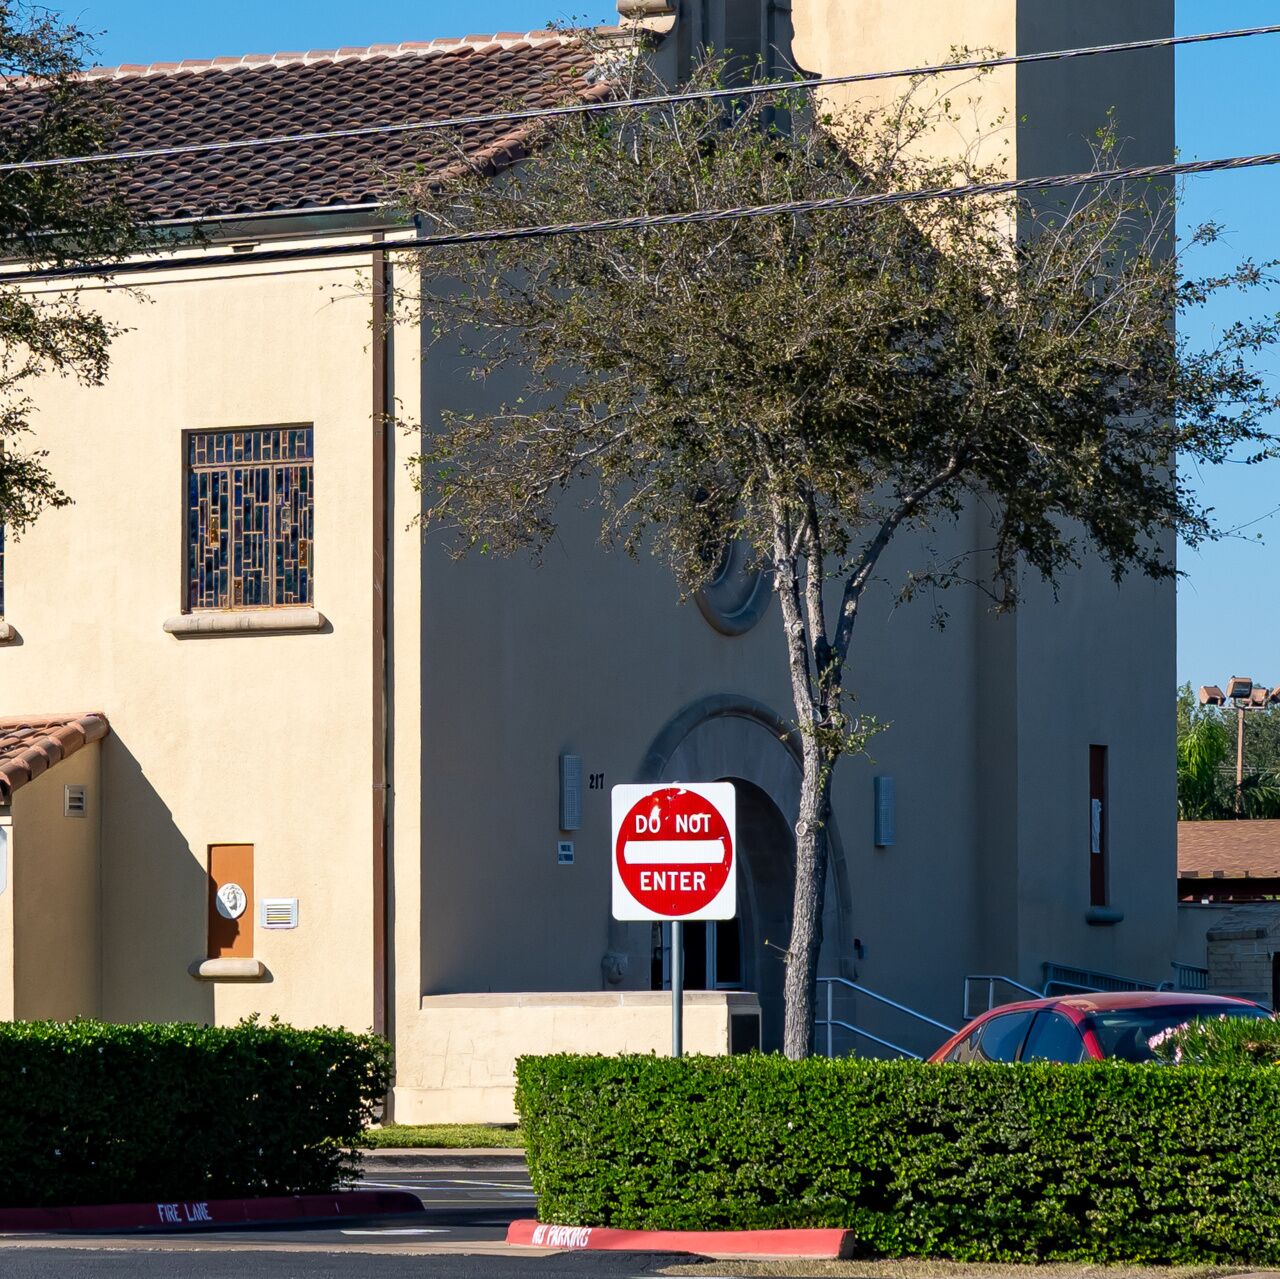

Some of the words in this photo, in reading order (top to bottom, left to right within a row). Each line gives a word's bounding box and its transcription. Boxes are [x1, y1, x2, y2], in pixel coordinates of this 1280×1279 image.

[589, 773, 604, 789] 217
[635, 814, 661, 833] DO
[675, 814, 711, 833] NOT
[640, 871, 706, 891] ENTER
[157, 1204, 182, 1222] FIRE
[184, 1203, 212, 1221] LANE
[532, 1225, 548, 1245] NO
[546, 1225, 592, 1247] PARKING
